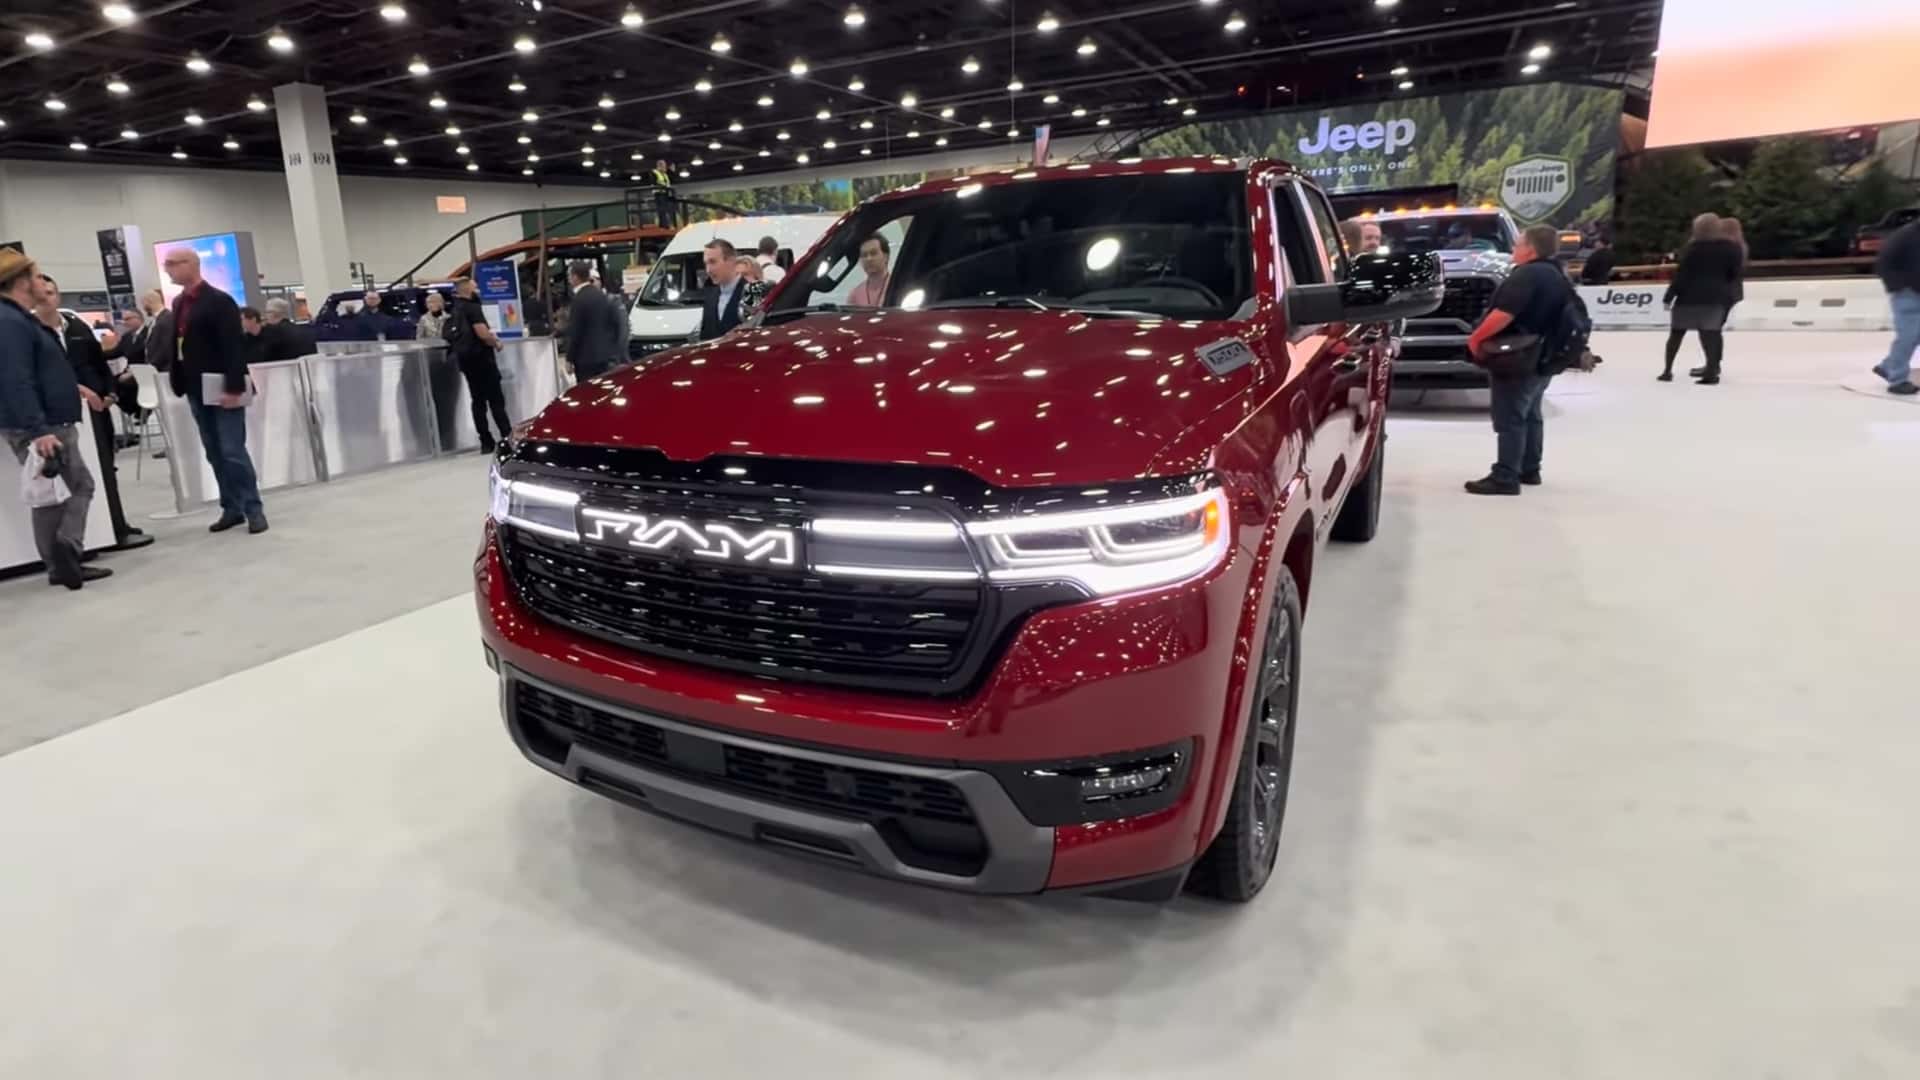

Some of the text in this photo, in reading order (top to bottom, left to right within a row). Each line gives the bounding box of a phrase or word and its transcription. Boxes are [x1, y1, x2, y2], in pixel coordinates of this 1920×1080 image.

[1298, 117, 1416, 154] Jeep
[1350, 158, 1381, 173] ONLY
[1597, 289, 1653, 307] Jeep
[582, 508, 794, 565] RAM
